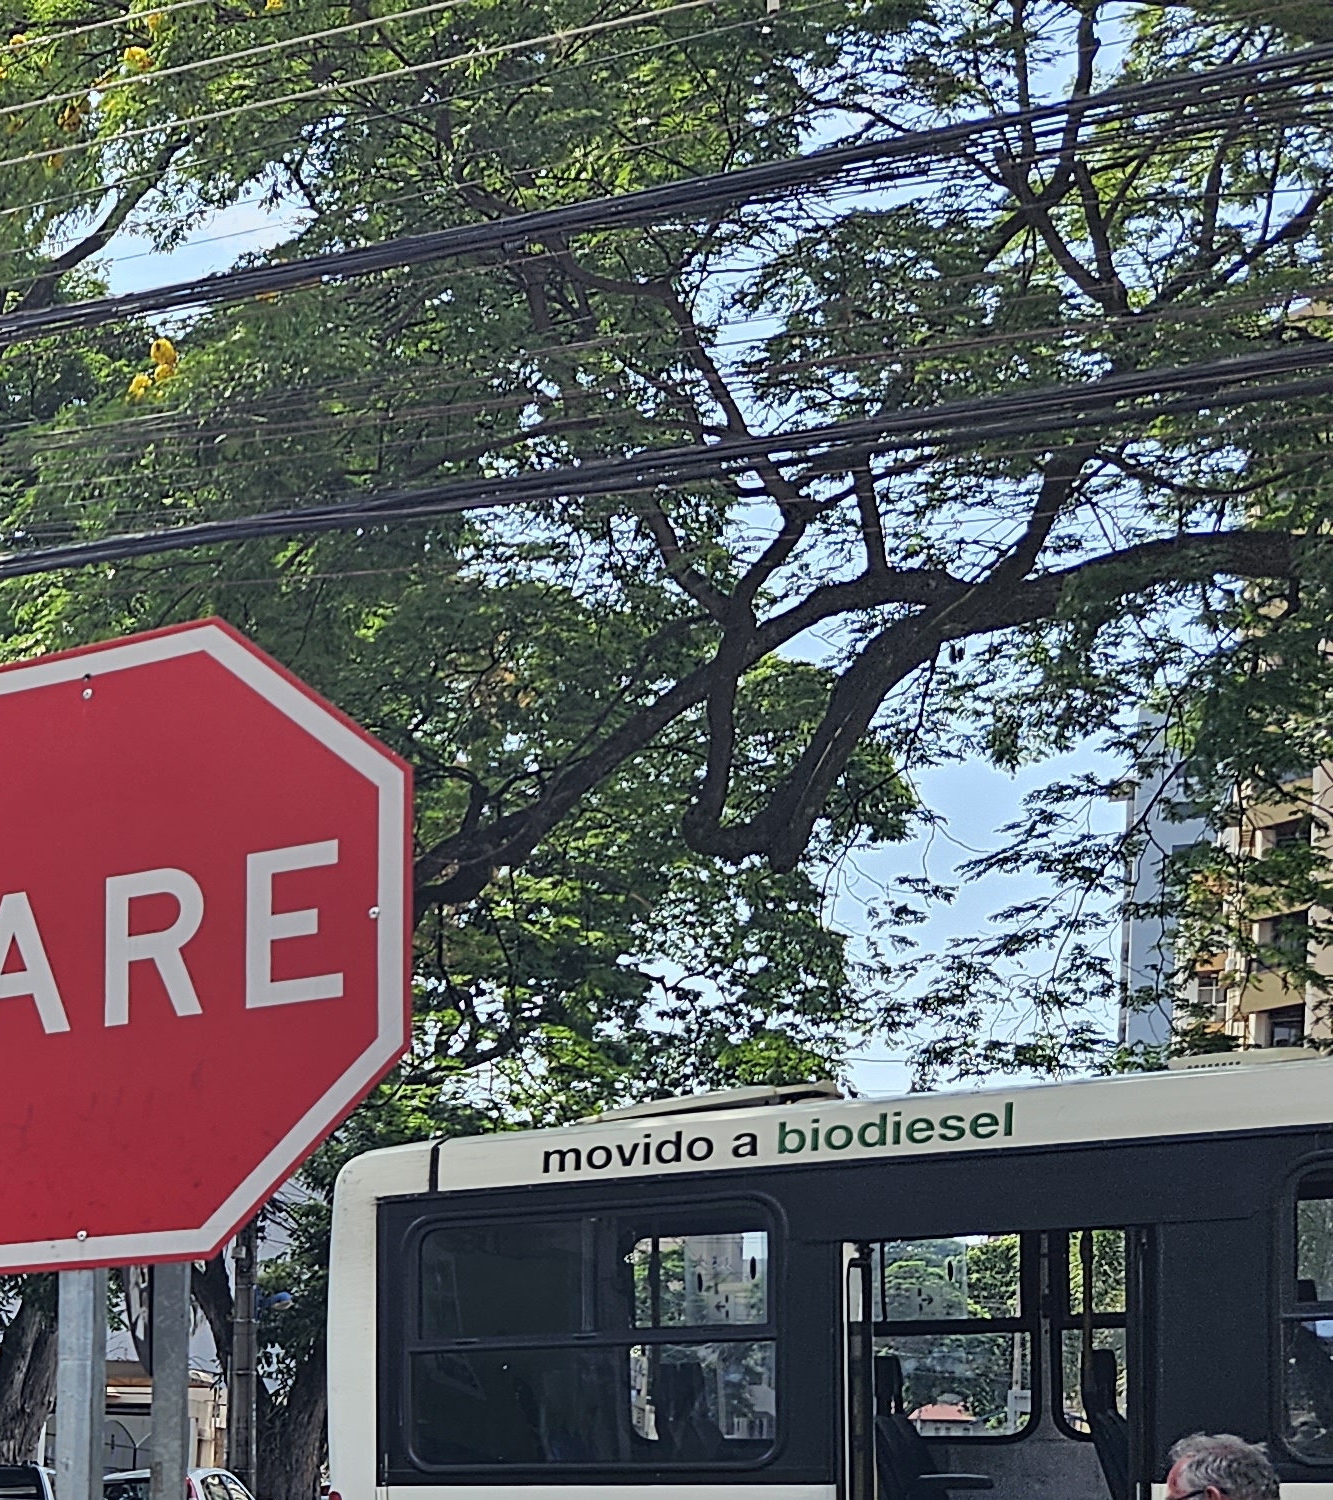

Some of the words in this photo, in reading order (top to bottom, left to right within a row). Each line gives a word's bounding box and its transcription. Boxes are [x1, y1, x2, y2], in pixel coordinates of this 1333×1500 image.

[542, 1130, 714, 1173] movido
[732, 1132, 759, 1158] a
[777, 1102, 1014, 1154] biodiesel
